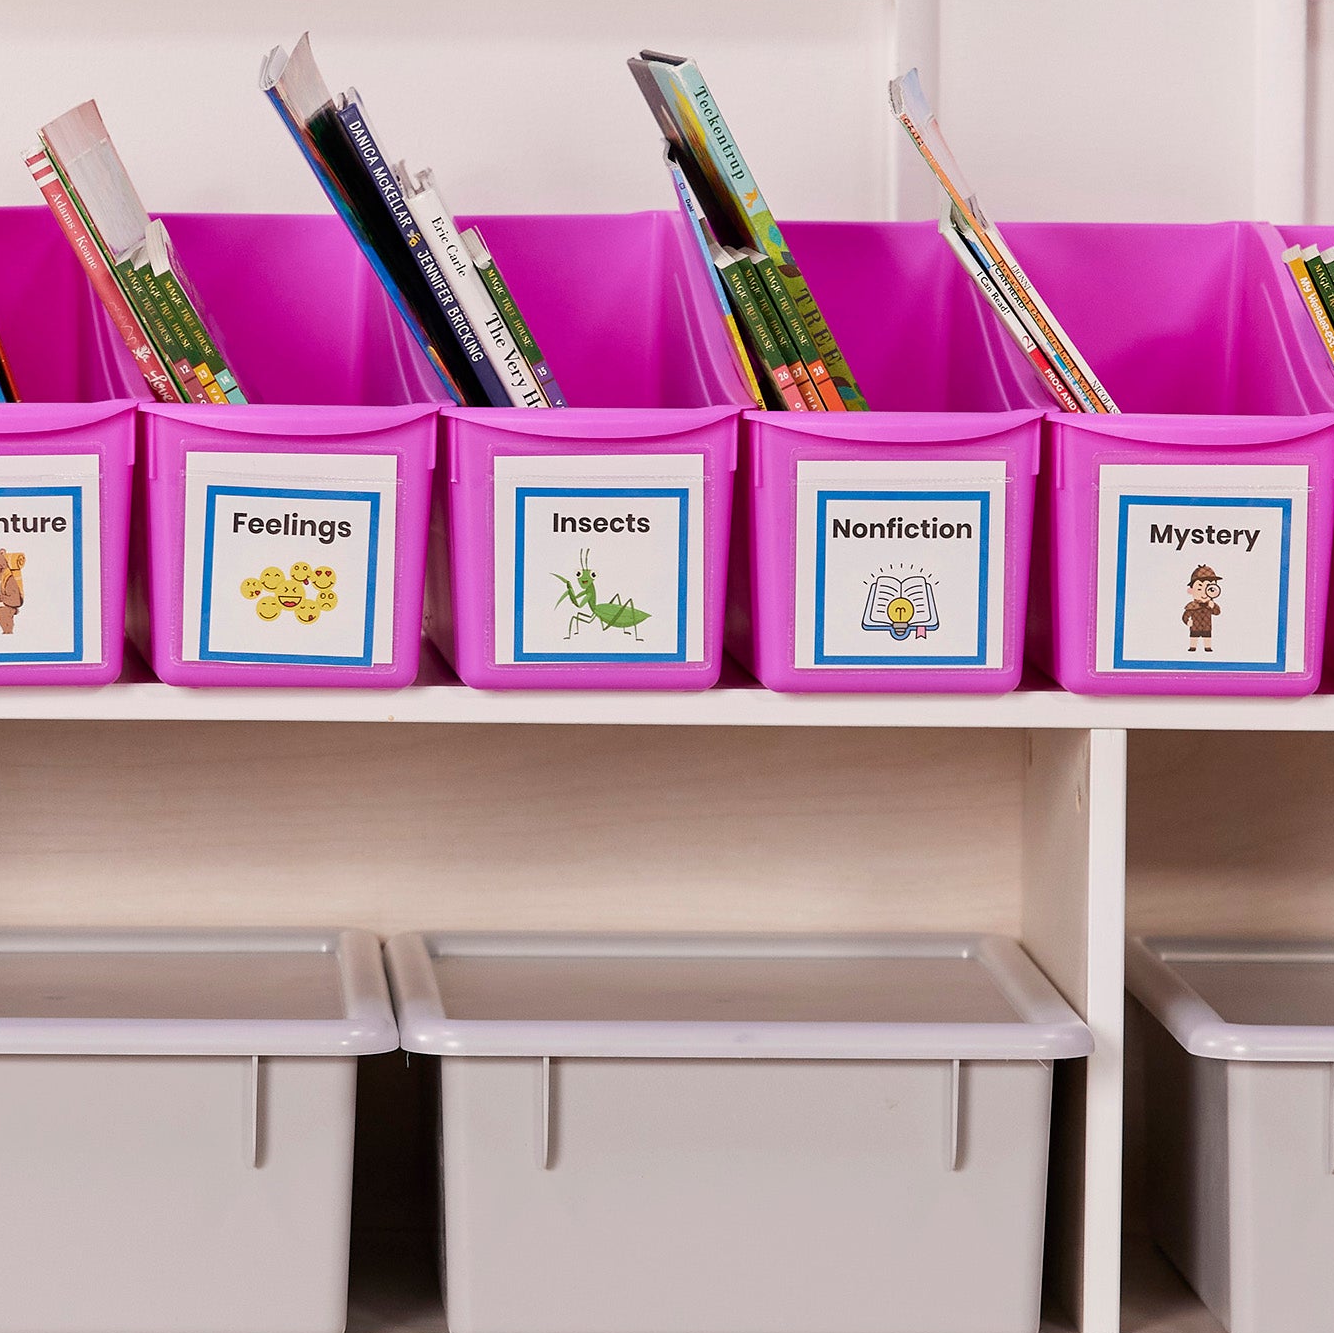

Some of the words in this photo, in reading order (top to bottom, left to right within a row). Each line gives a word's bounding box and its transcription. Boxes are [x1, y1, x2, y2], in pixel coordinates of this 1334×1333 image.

[349, 120, 379, 166] DANICA
[693, 85, 745, 180] Teckentrup
[51, 193, 75, 229] Adams
[75, 235, 98, 269] Keane
[431, 216, 449, 244] Eric
[446, 244, 466, 278] Carle
[417, 249, 454, 306] JENNIFER
[447, 306, 484, 362] BRICKING
[980, 276, 993, 293] Can
[991, 291, 1011, 316] Read!
[793, 287, 842, 366] TREE
[1022, 335, 1034, 350] 2
[484, 312, 506, 348] The
[503, 347, 527, 388] Very
[523, 389, 543, 408] H
[537, 367, 548, 377] 15
[792, 367, 803, 378] 27
[813, 365, 825, 377] 28
[143, 370, 174, 402] Love
[777, 371, 789, 383] 26
[1044, 368, 1064, 393] FROG
[1061, 391, 1077, 411] AND
[232, 512, 352, 544] Feelings
[552, 512, 651, 533] Insects
[831, 517, 973, 539] Nonfiction
[1149, 523, 1261, 552] Mystery
